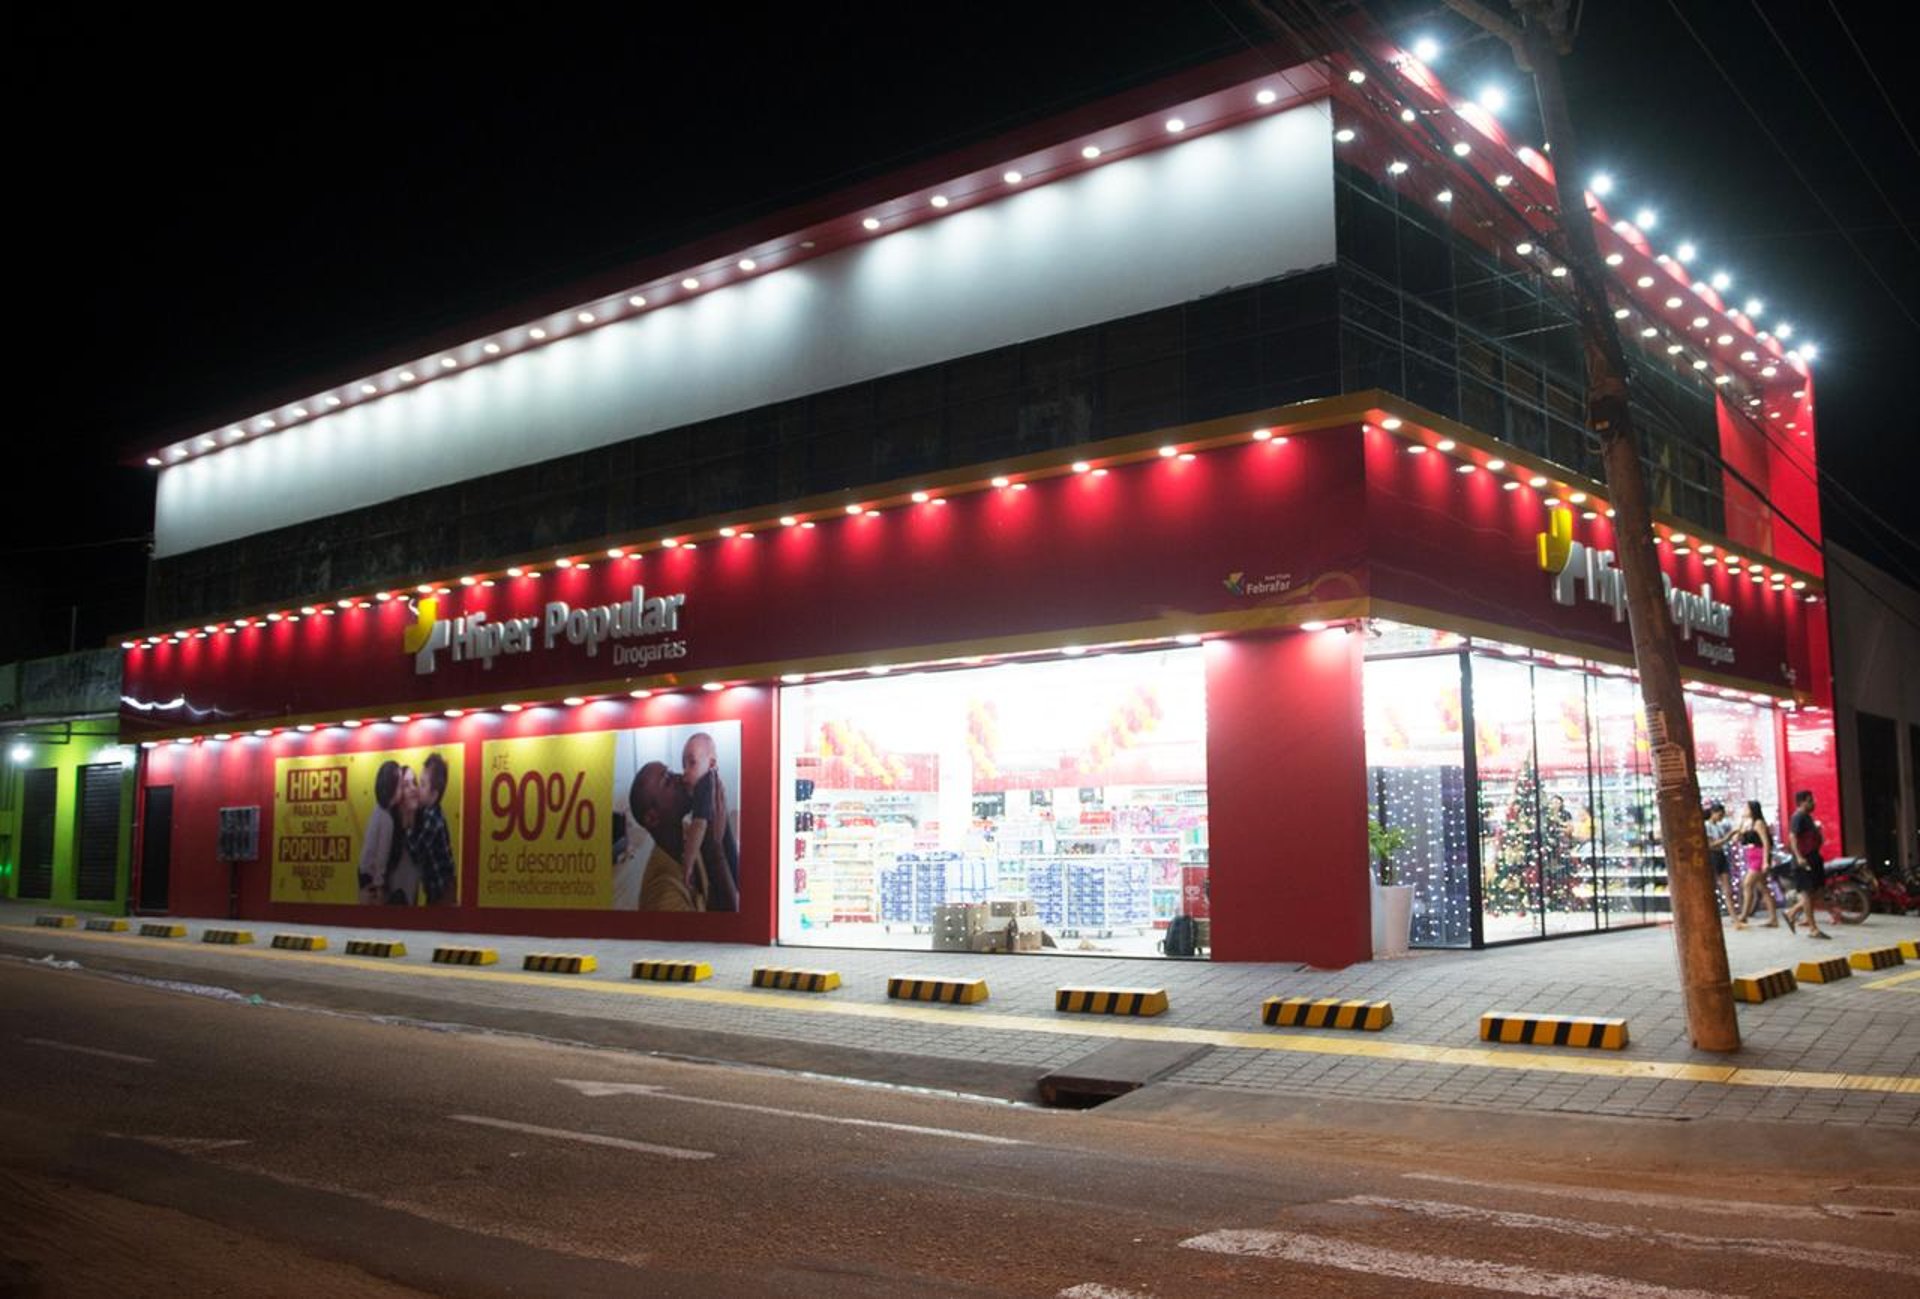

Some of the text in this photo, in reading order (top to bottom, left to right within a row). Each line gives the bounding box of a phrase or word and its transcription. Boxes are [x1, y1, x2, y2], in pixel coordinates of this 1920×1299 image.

[1246, 580, 1290, 595] Febrafar
[1585, 547, 1627, 623] Hip
[452, 585, 686, 670] Hiper Popular
[613, 638, 687, 668] Drogarias
[289, 769, 342, 800] HIPER
[490, 770, 596, 842] 90%
[281, 837, 348, 861] POPULAR
[488, 845, 597, 874] de desconto
